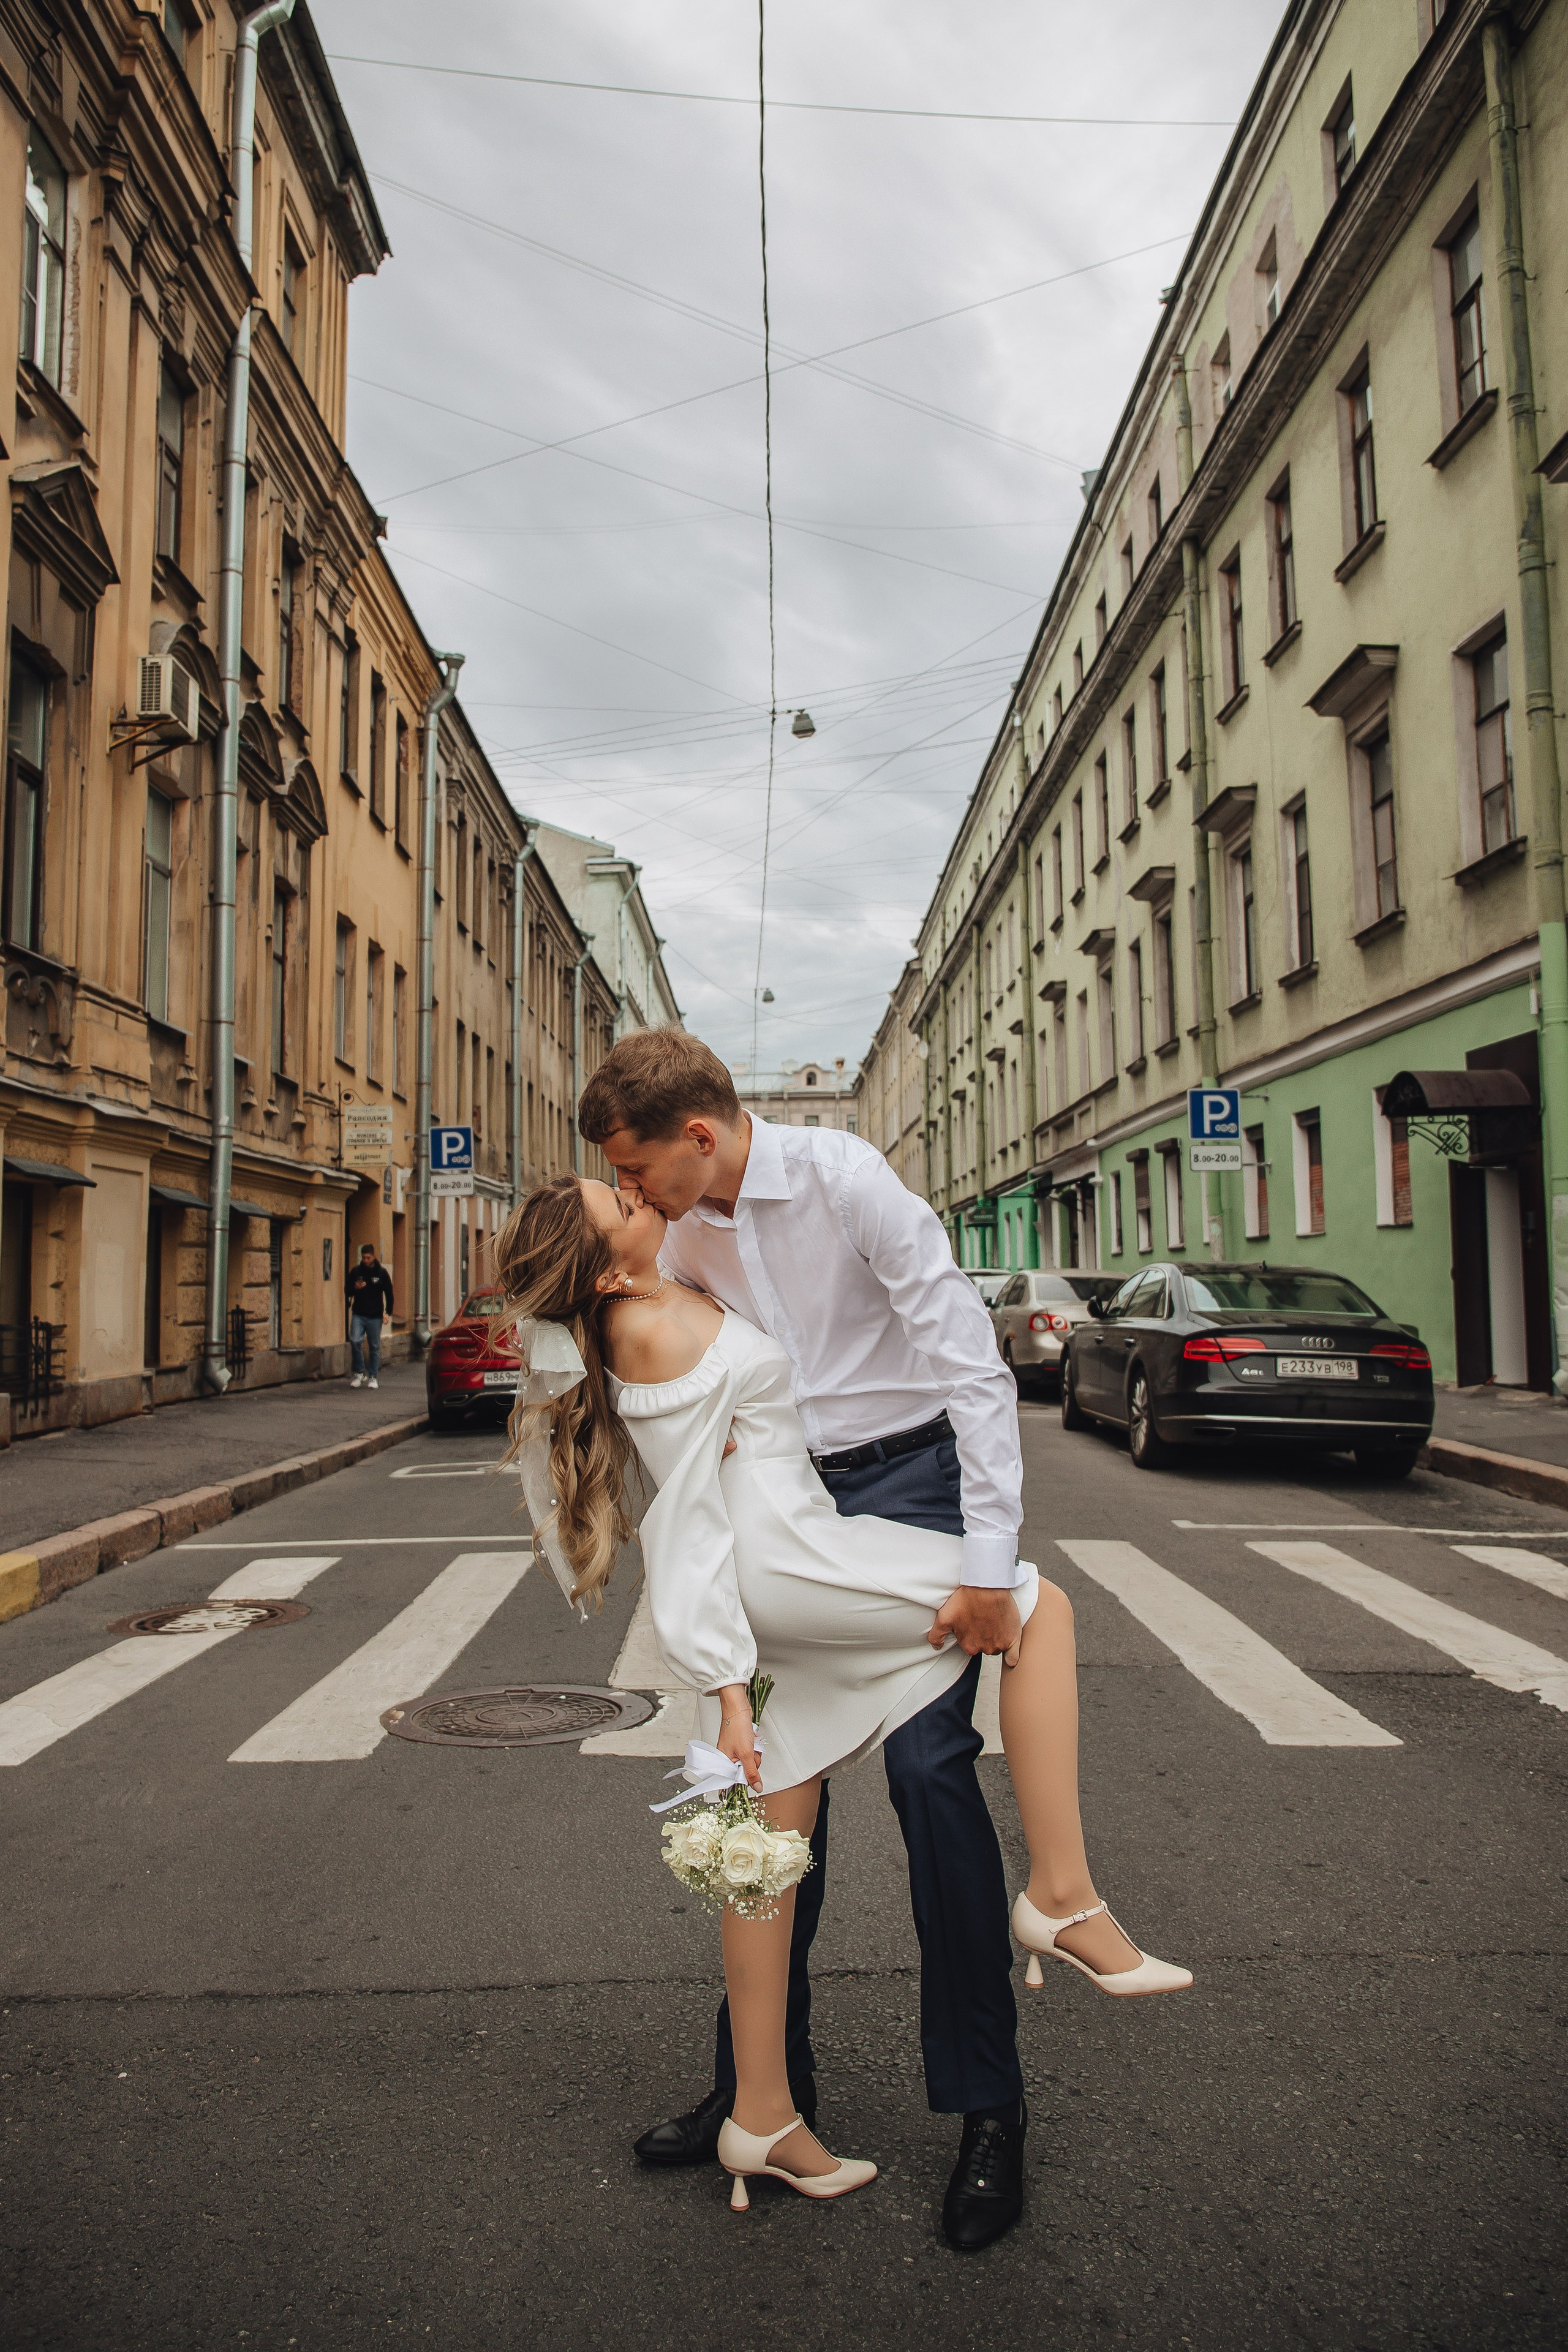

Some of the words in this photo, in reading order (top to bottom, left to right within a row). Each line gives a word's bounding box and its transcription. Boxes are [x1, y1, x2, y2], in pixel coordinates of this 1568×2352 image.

[1202, 1095, 1231, 1134] P
[442, 1131, 464, 1165] P
[1193, 1153, 1239, 1163] 8.00-20.00
[1334, 1361, 1352, 1372] 198
